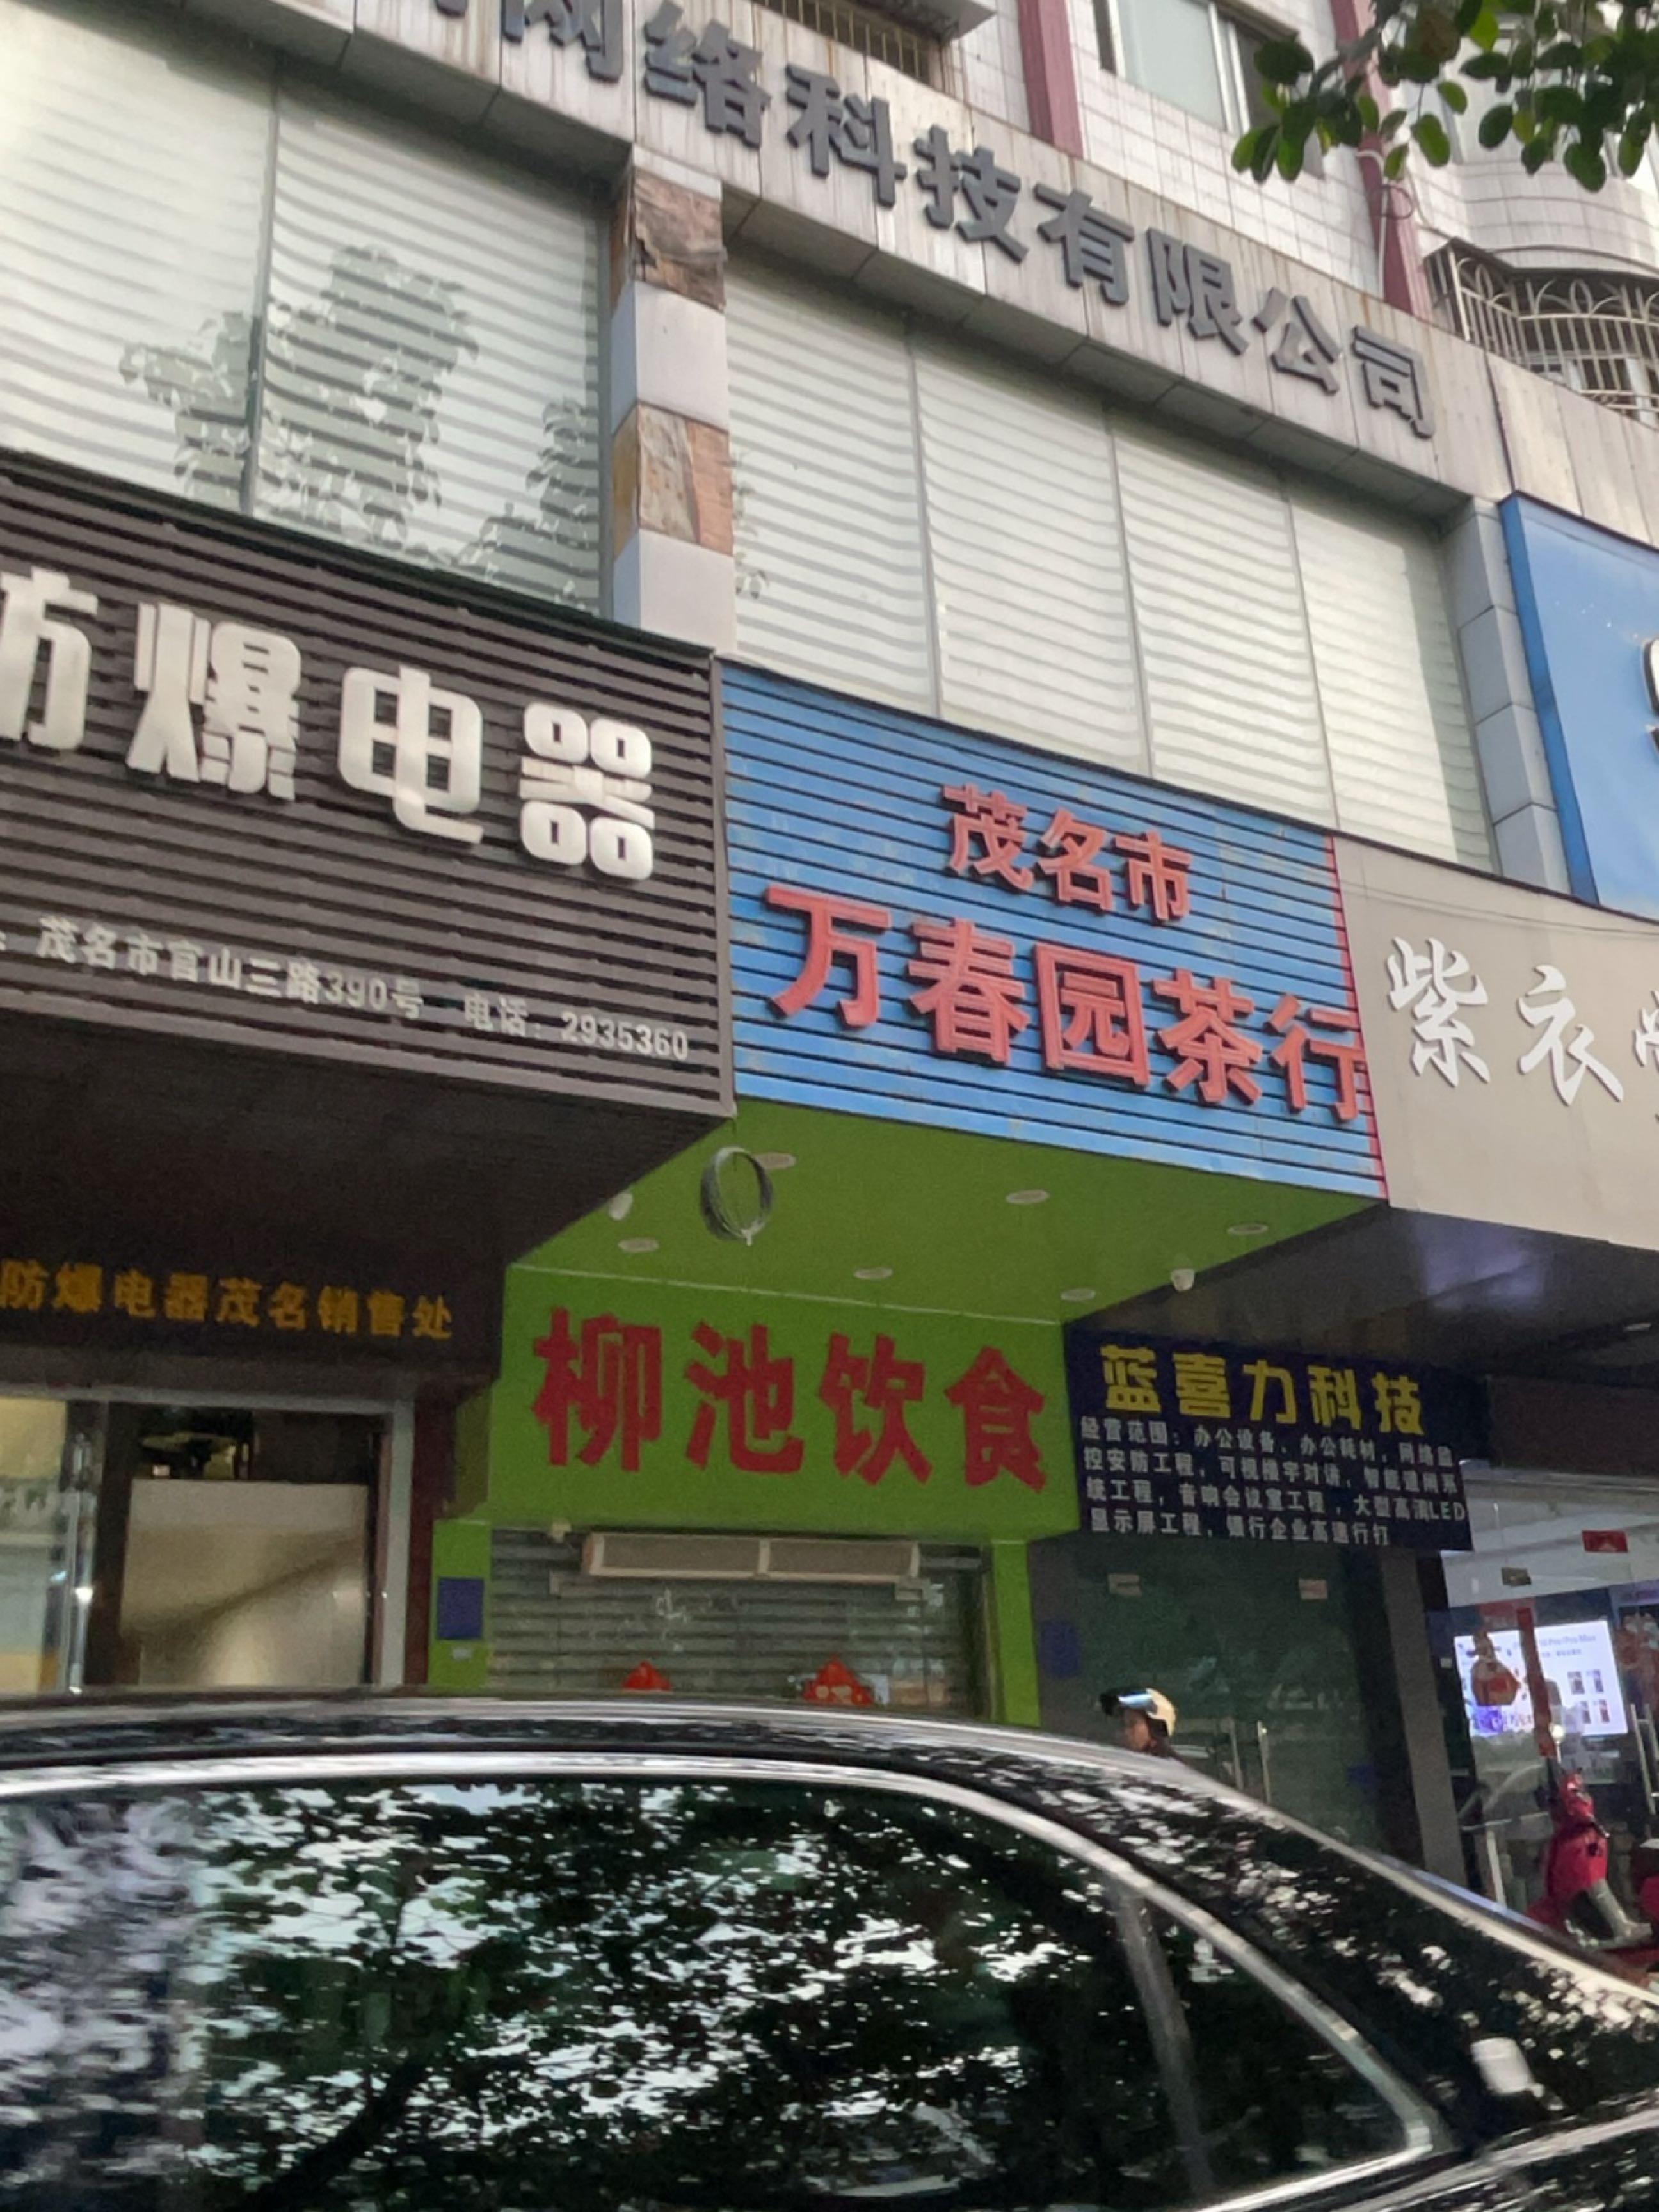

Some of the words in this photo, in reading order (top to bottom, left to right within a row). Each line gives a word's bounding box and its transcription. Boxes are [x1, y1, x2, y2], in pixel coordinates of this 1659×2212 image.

[433, 0, 1434, 438] 网络科技有限公司
[942, 783, 1192, 921] 茂名市
[767, 883, 1366, 1122] 万春园茶行
[1386, 936, 1659, 1125] 紫衣
[533, 1306, 1046, 1492] 柳池饮食
[1100, 1344, 1423, 1434] 蓝喜力科技
